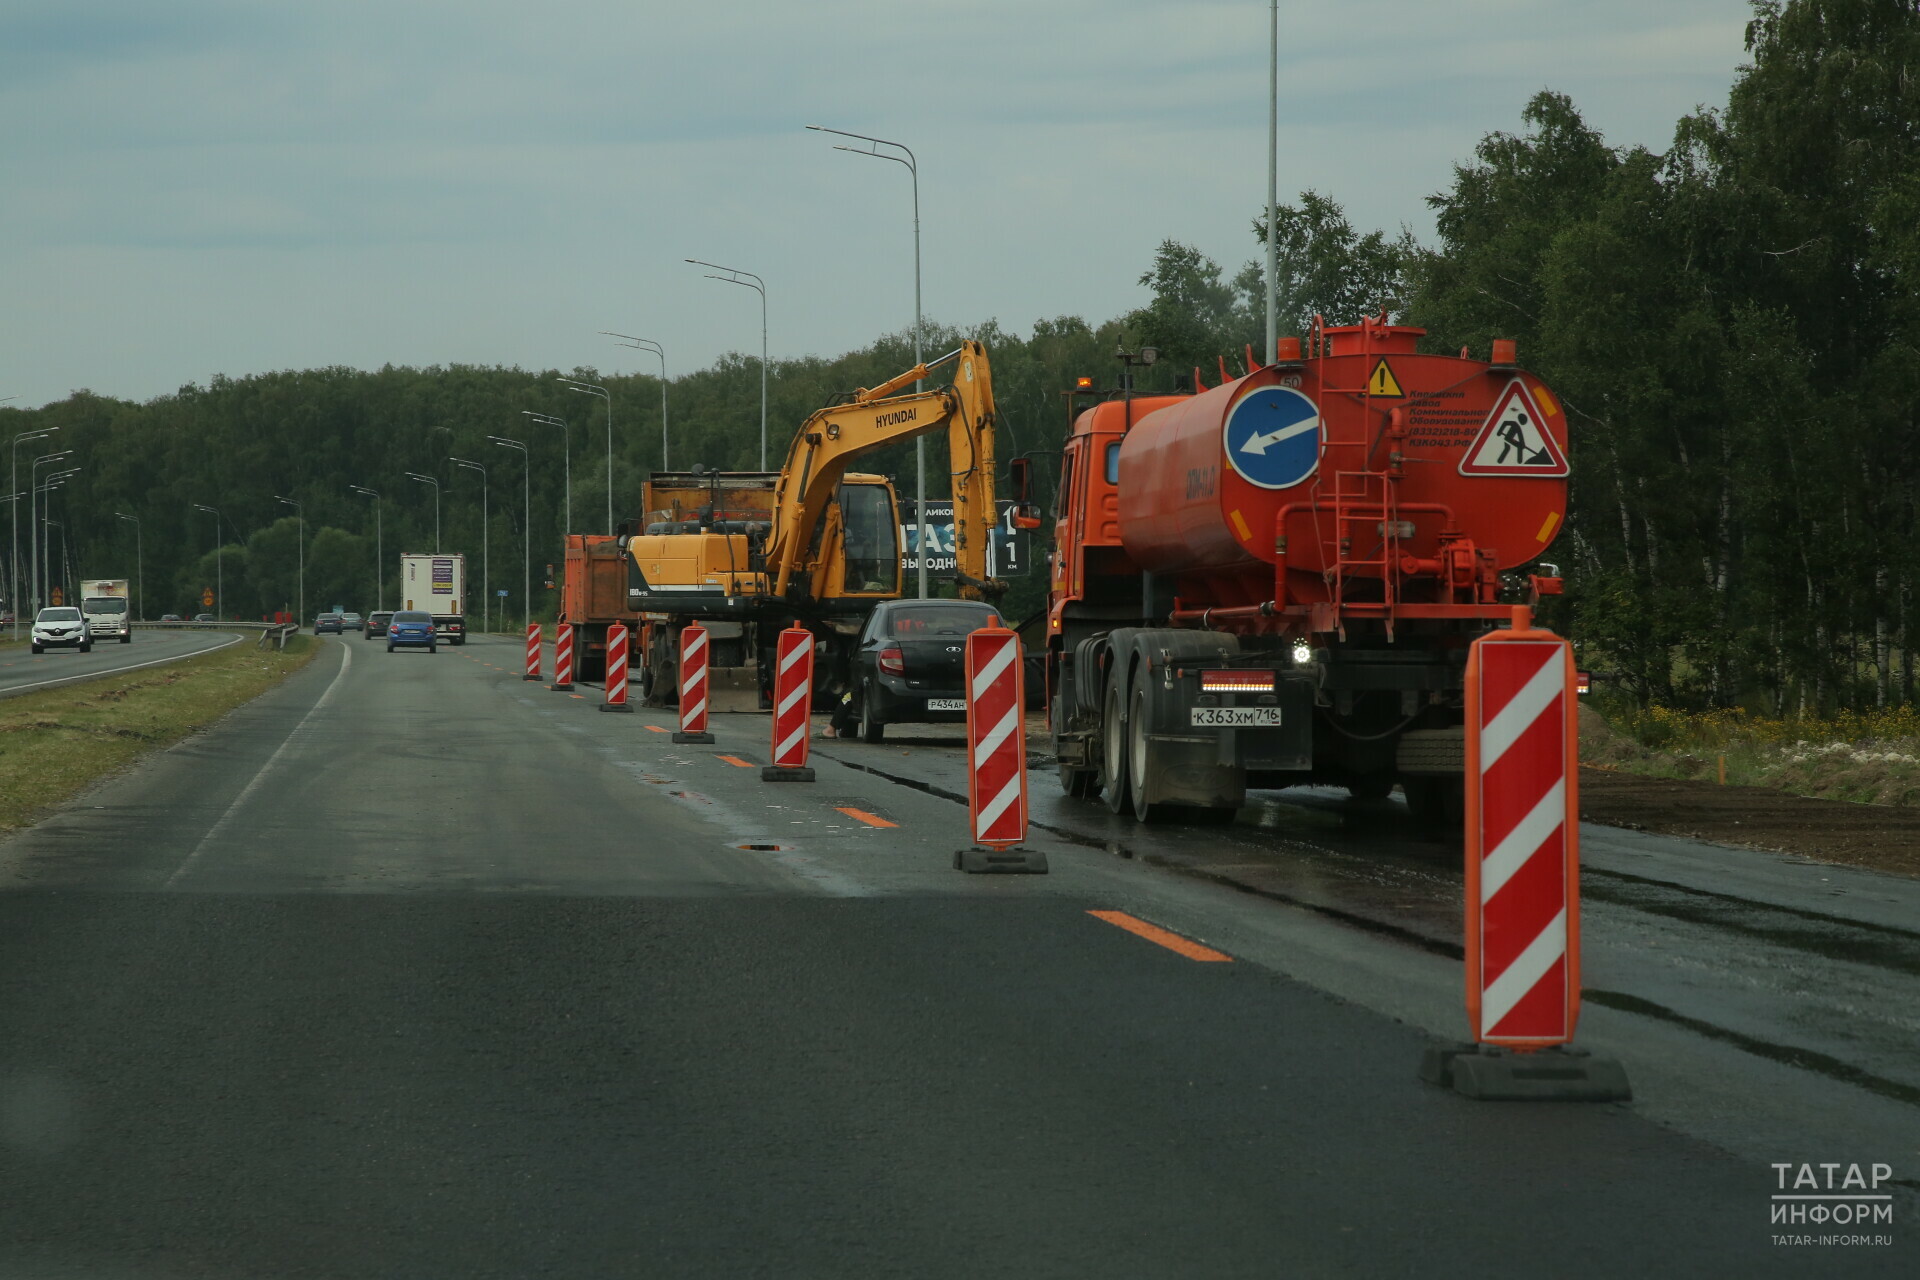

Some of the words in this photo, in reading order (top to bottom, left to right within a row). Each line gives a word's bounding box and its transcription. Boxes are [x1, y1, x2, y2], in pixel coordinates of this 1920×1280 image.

[1284, 377, 1300, 388] 50
[876, 408, 917, 428] HYUNDAI
[1005, 541, 1016, 562] 1
[1255, 708, 1277, 720] 716
